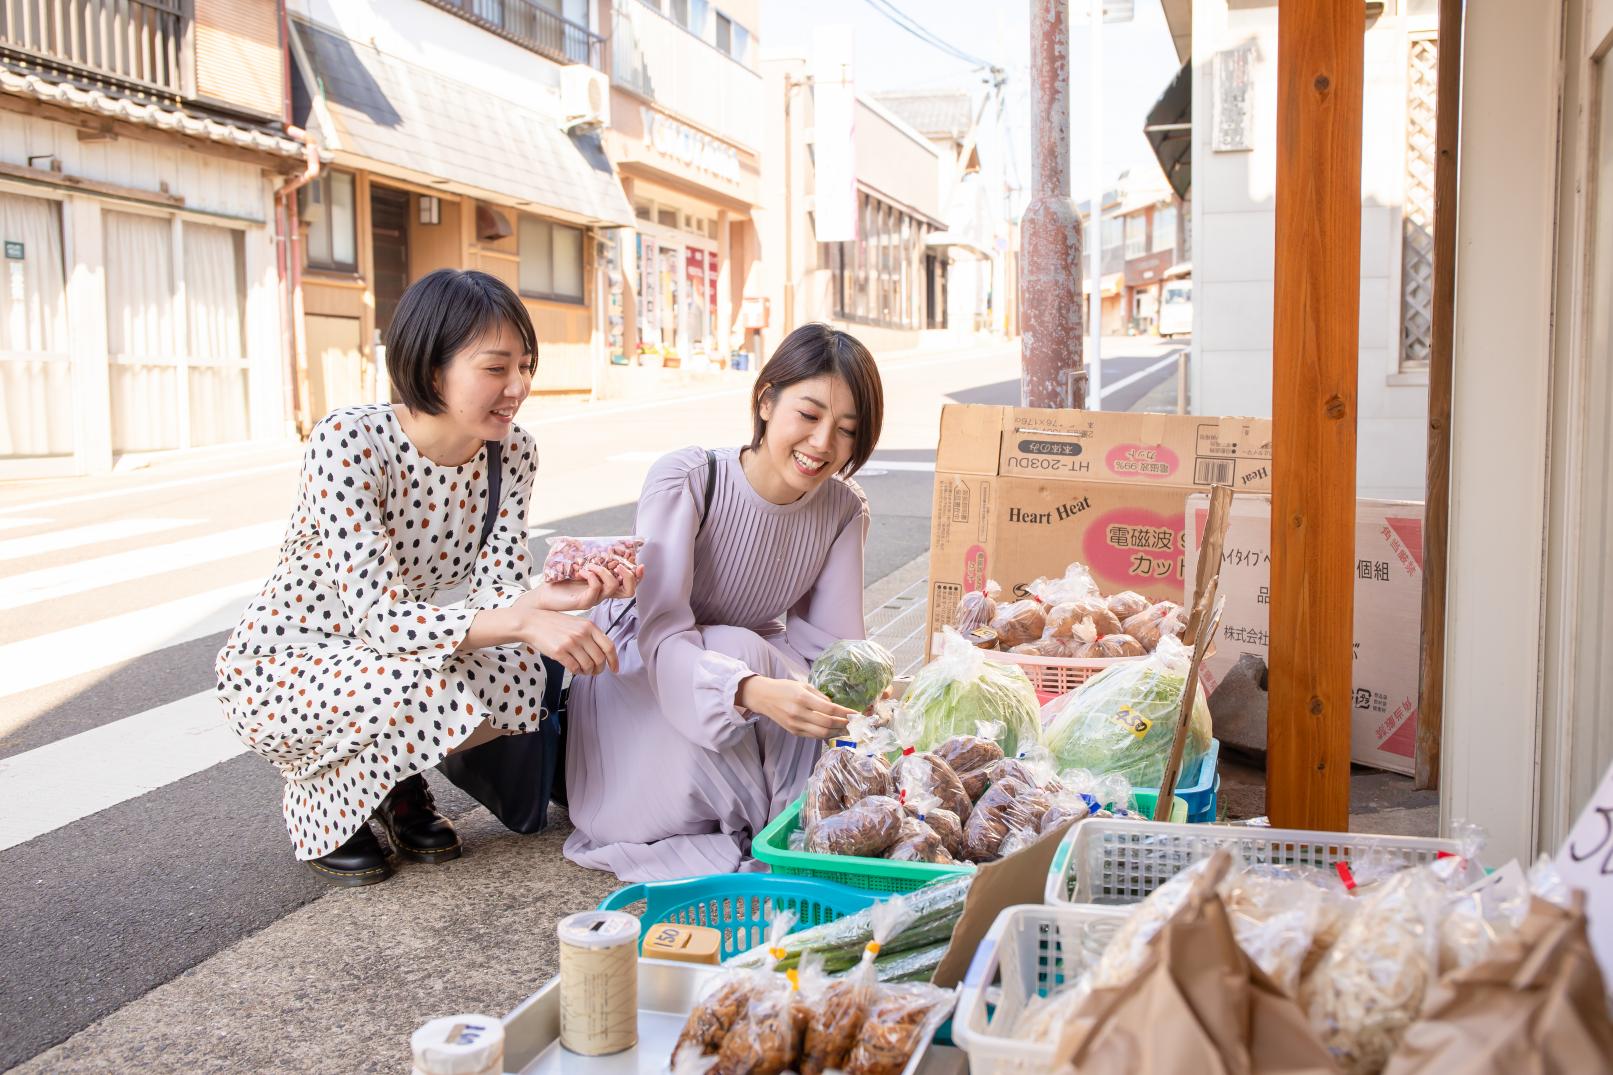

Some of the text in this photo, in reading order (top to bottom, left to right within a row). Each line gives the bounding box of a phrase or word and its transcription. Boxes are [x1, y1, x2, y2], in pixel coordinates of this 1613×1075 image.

[1029, 442, 1073, 454] 本体のみ
[1127, 450, 1156, 460] カット
[1007, 456, 1090, 472] HT-203DU
[1140, 463, 1169, 473] 電磁波
[1241, 466, 1268, 487] Heat
[1008, 507, 1052, 525] Heart
[1056, 495, 1092, 521] Heat
[1109, 526, 1173, 550] 電磁波
[653, 928, 679, 947] 150
